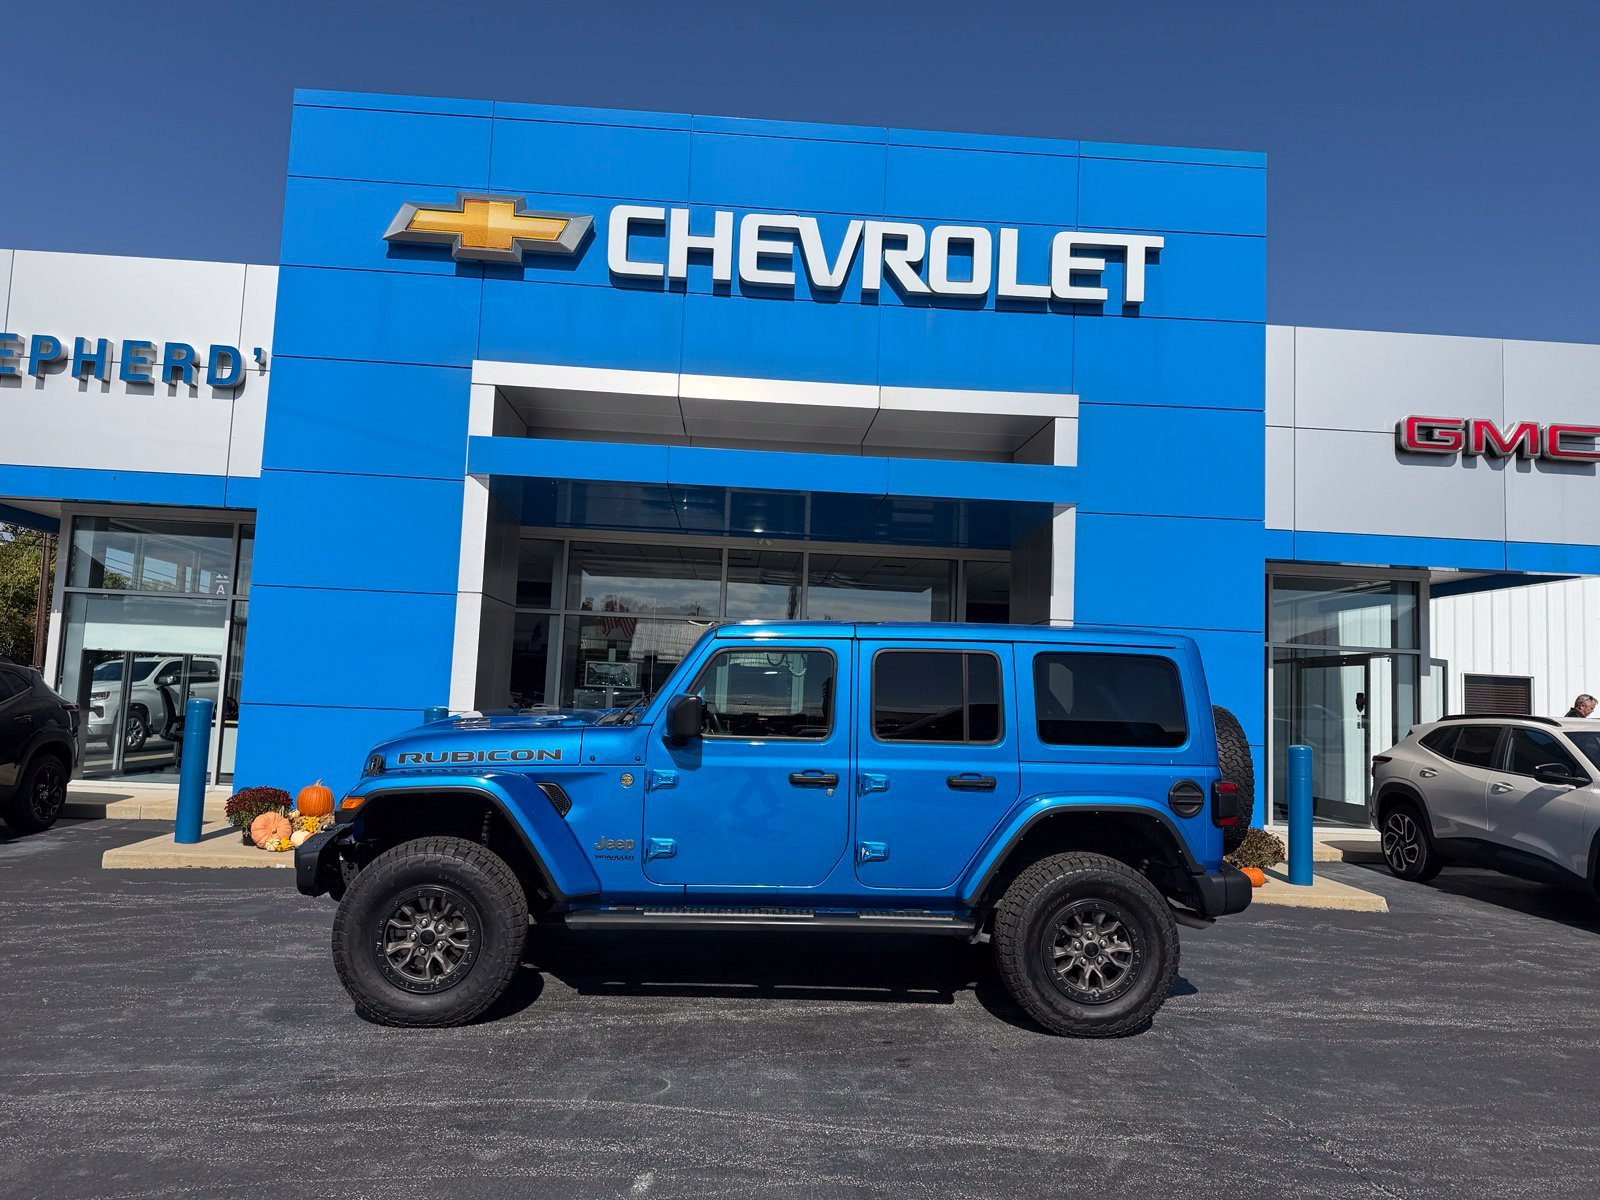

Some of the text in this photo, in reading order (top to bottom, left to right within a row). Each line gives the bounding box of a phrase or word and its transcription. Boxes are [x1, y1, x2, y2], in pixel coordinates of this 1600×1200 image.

[607, 204, 1165, 303] CHEVROLET
[1400, 414, 1600, 464] GMC
[397, 748, 563, 765] RUBICON
[594, 835, 635, 851] Jeep
